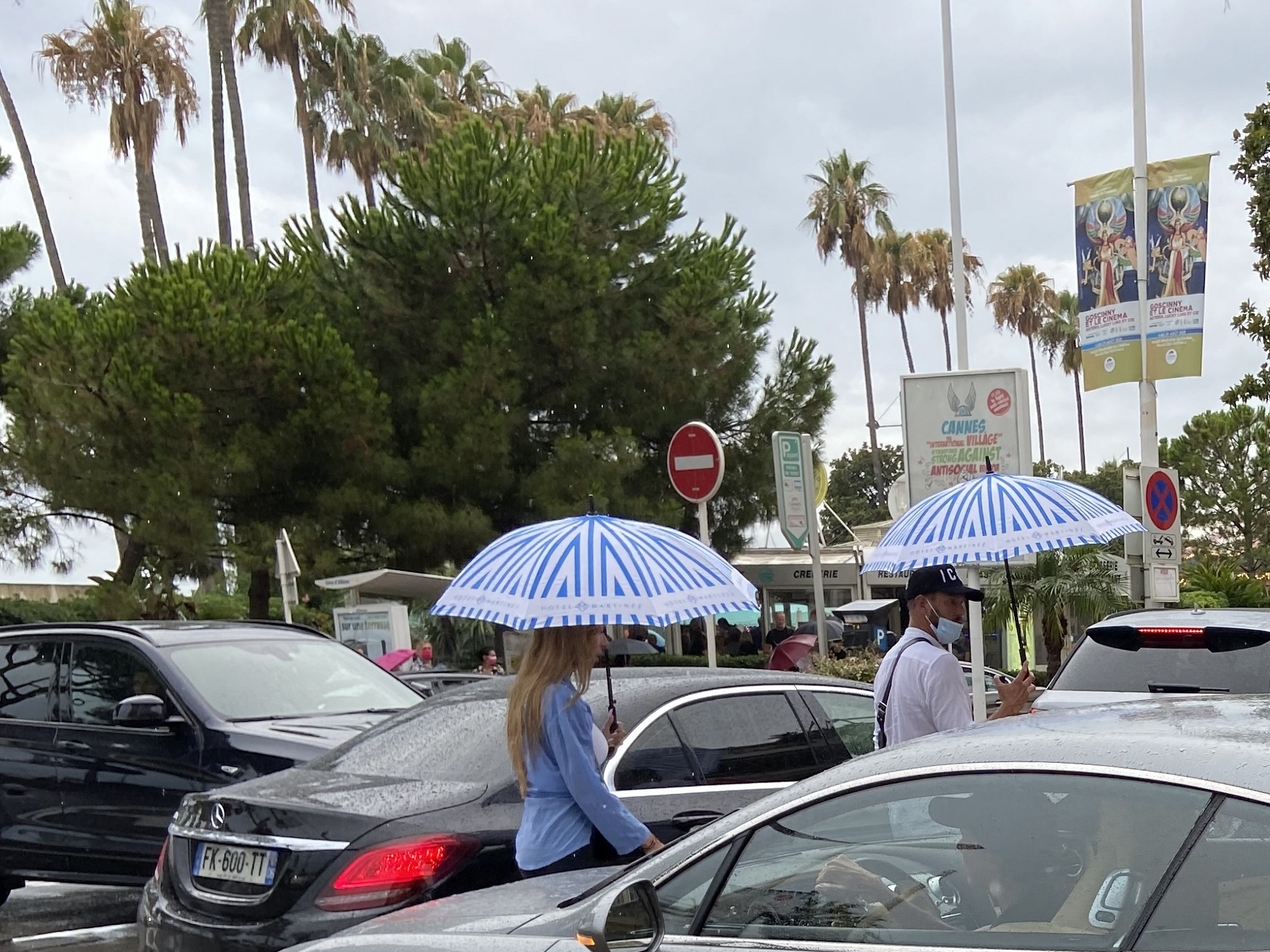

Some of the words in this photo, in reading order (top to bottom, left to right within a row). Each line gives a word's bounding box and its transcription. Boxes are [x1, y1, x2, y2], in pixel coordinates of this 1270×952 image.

[1150, 300, 1182, 310] GOSCINNY
[1085, 309, 1115, 321] GOSCINNY
[1094, 317, 1102, 325] LE
[958, 446, 1002, 463] AGAINST
[930, 463, 977, 476] ANTISOCIAL
[794, 570, 838, 579] CRERIE
[591, 602, 642, 610] MARTINEZ
[877, 628, 885, 646] P
[202, 846, 267, 877] FK-600-TT
